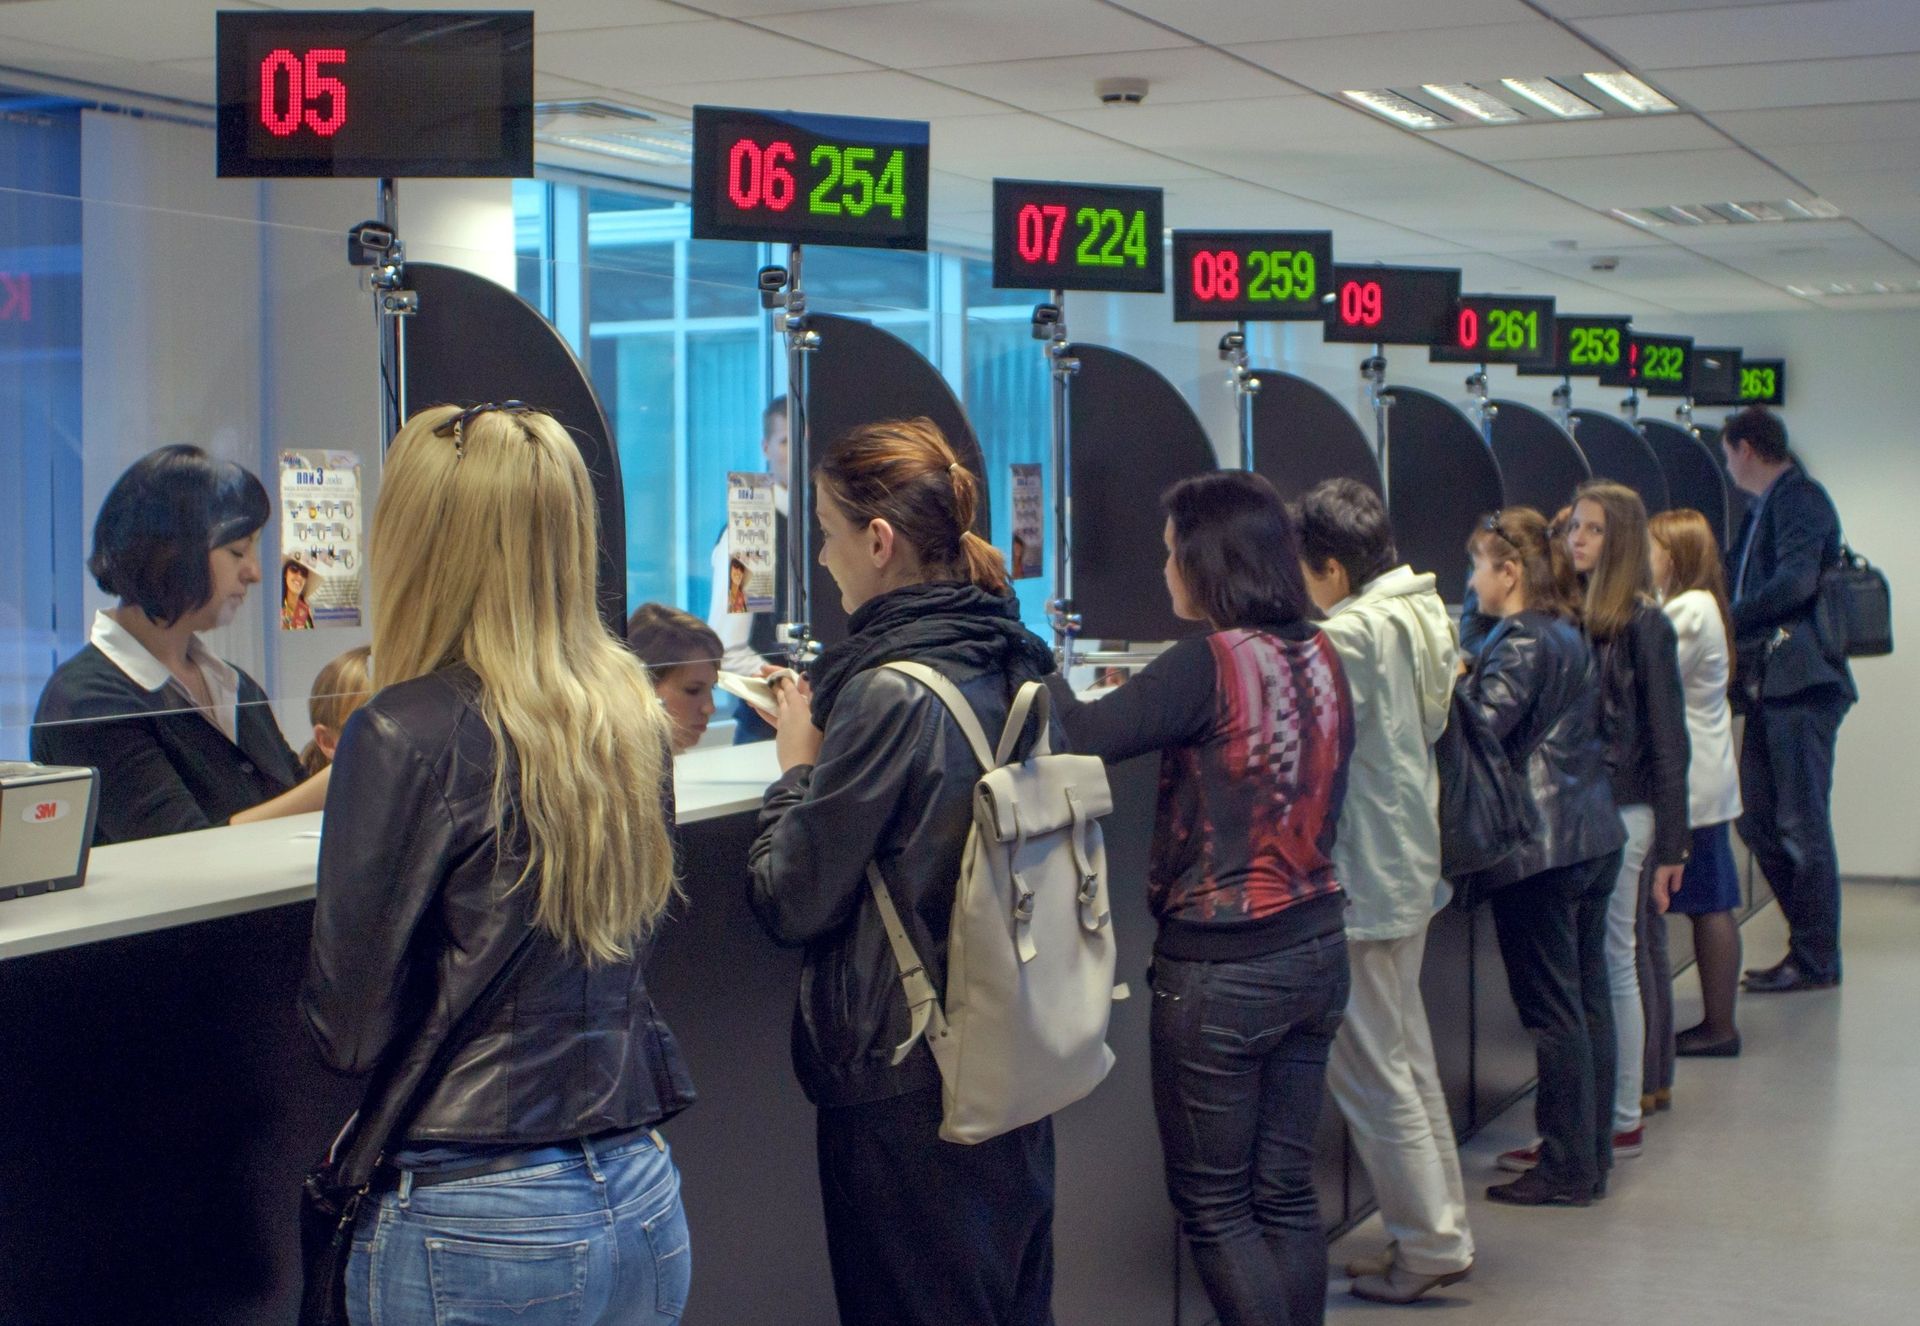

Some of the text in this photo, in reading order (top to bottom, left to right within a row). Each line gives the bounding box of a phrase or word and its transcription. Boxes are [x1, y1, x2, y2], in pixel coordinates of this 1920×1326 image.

[260, 48, 347, 137] 05
[728, 138, 907, 220] 06 254
[1017, 203, 1148, 268] 07 224
[1192, 250, 1316, 301] 08 259
[1341, 281, 1382, 326] 09
[1459, 308, 1538, 350] 0 261
[1569, 327, 1620, 365] 253
[1643, 345, 1684, 380] 232
[35, 802, 57, 820] 3M
